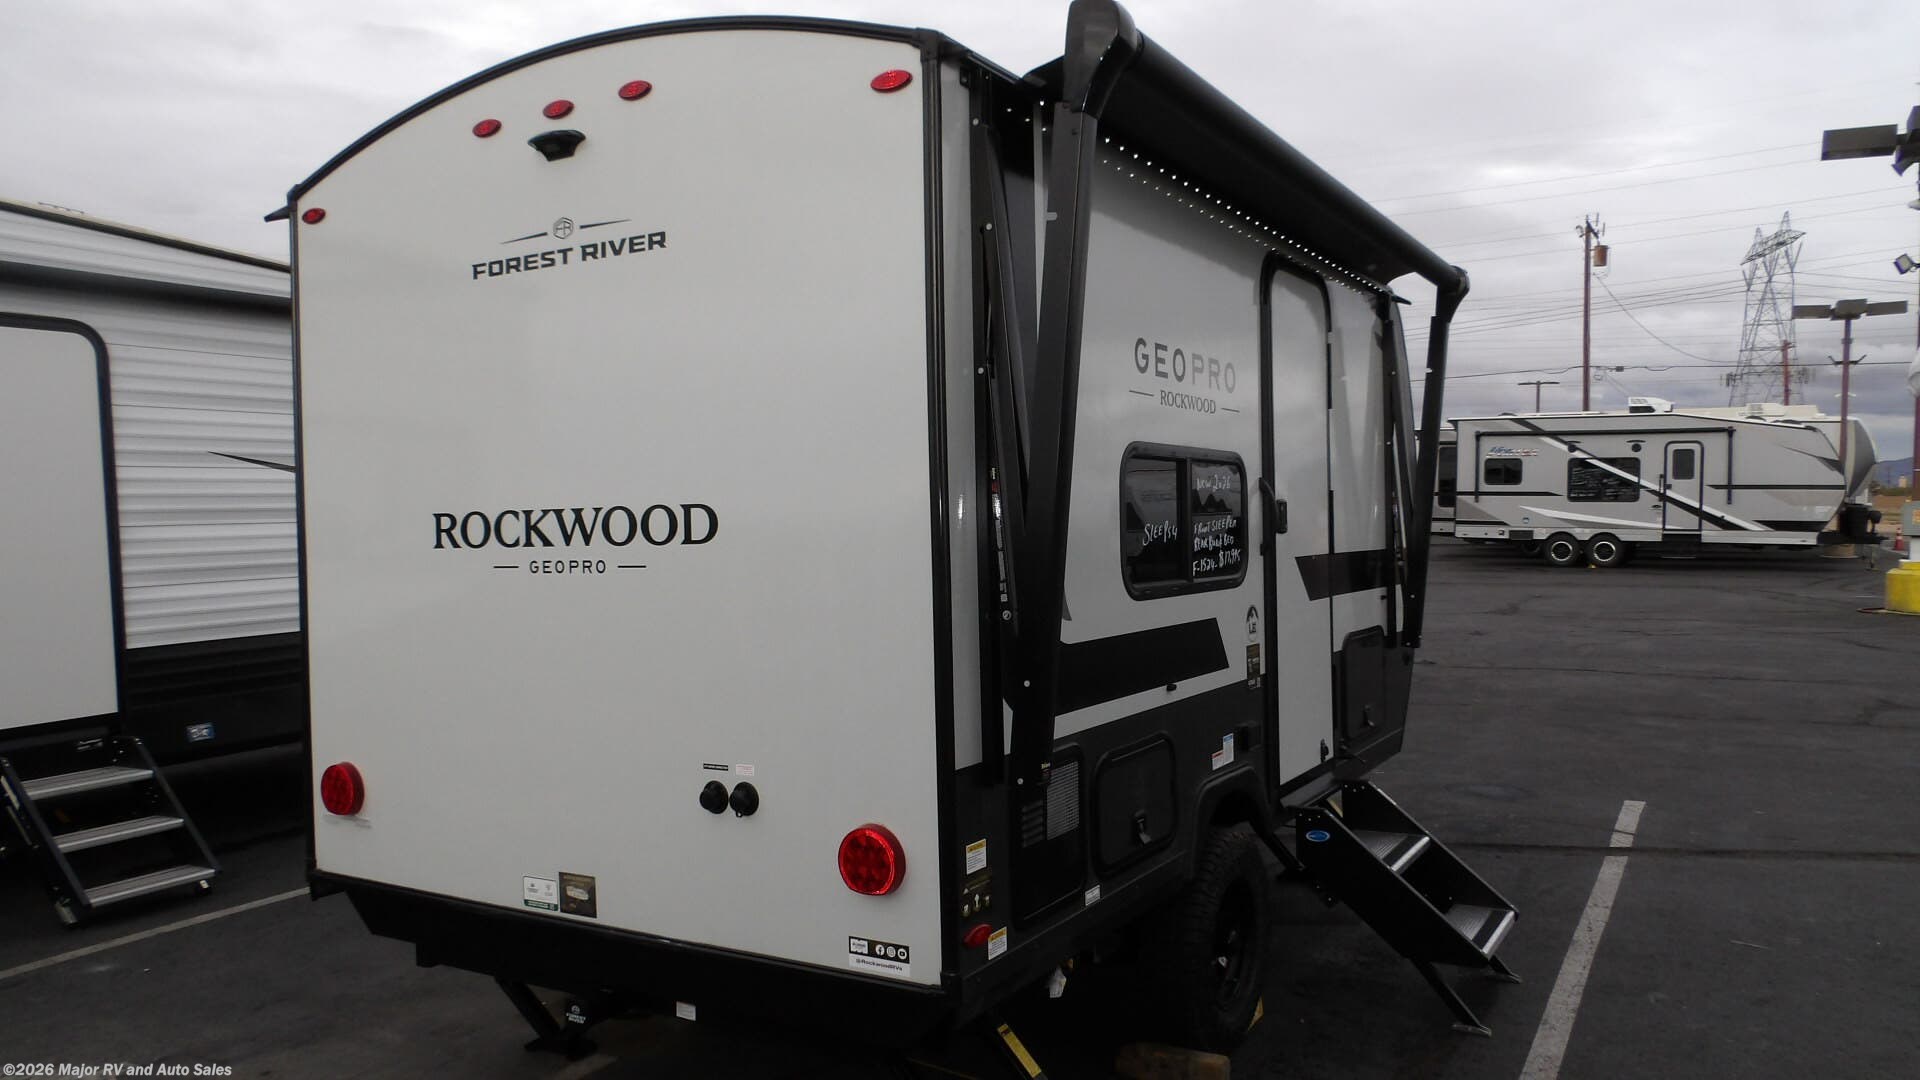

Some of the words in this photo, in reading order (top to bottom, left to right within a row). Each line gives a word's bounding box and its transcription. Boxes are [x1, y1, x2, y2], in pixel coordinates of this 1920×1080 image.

[471, 247, 574, 281] FOREST
[580, 230, 667, 262] RIVER
[1134, 336, 1237, 395] GEOPRO
[1159, 388, 1217, 415] ROCKWOOD
[432, 503, 719, 550] ROCKWOOD
[529, 559, 607, 575] GEOPRO
